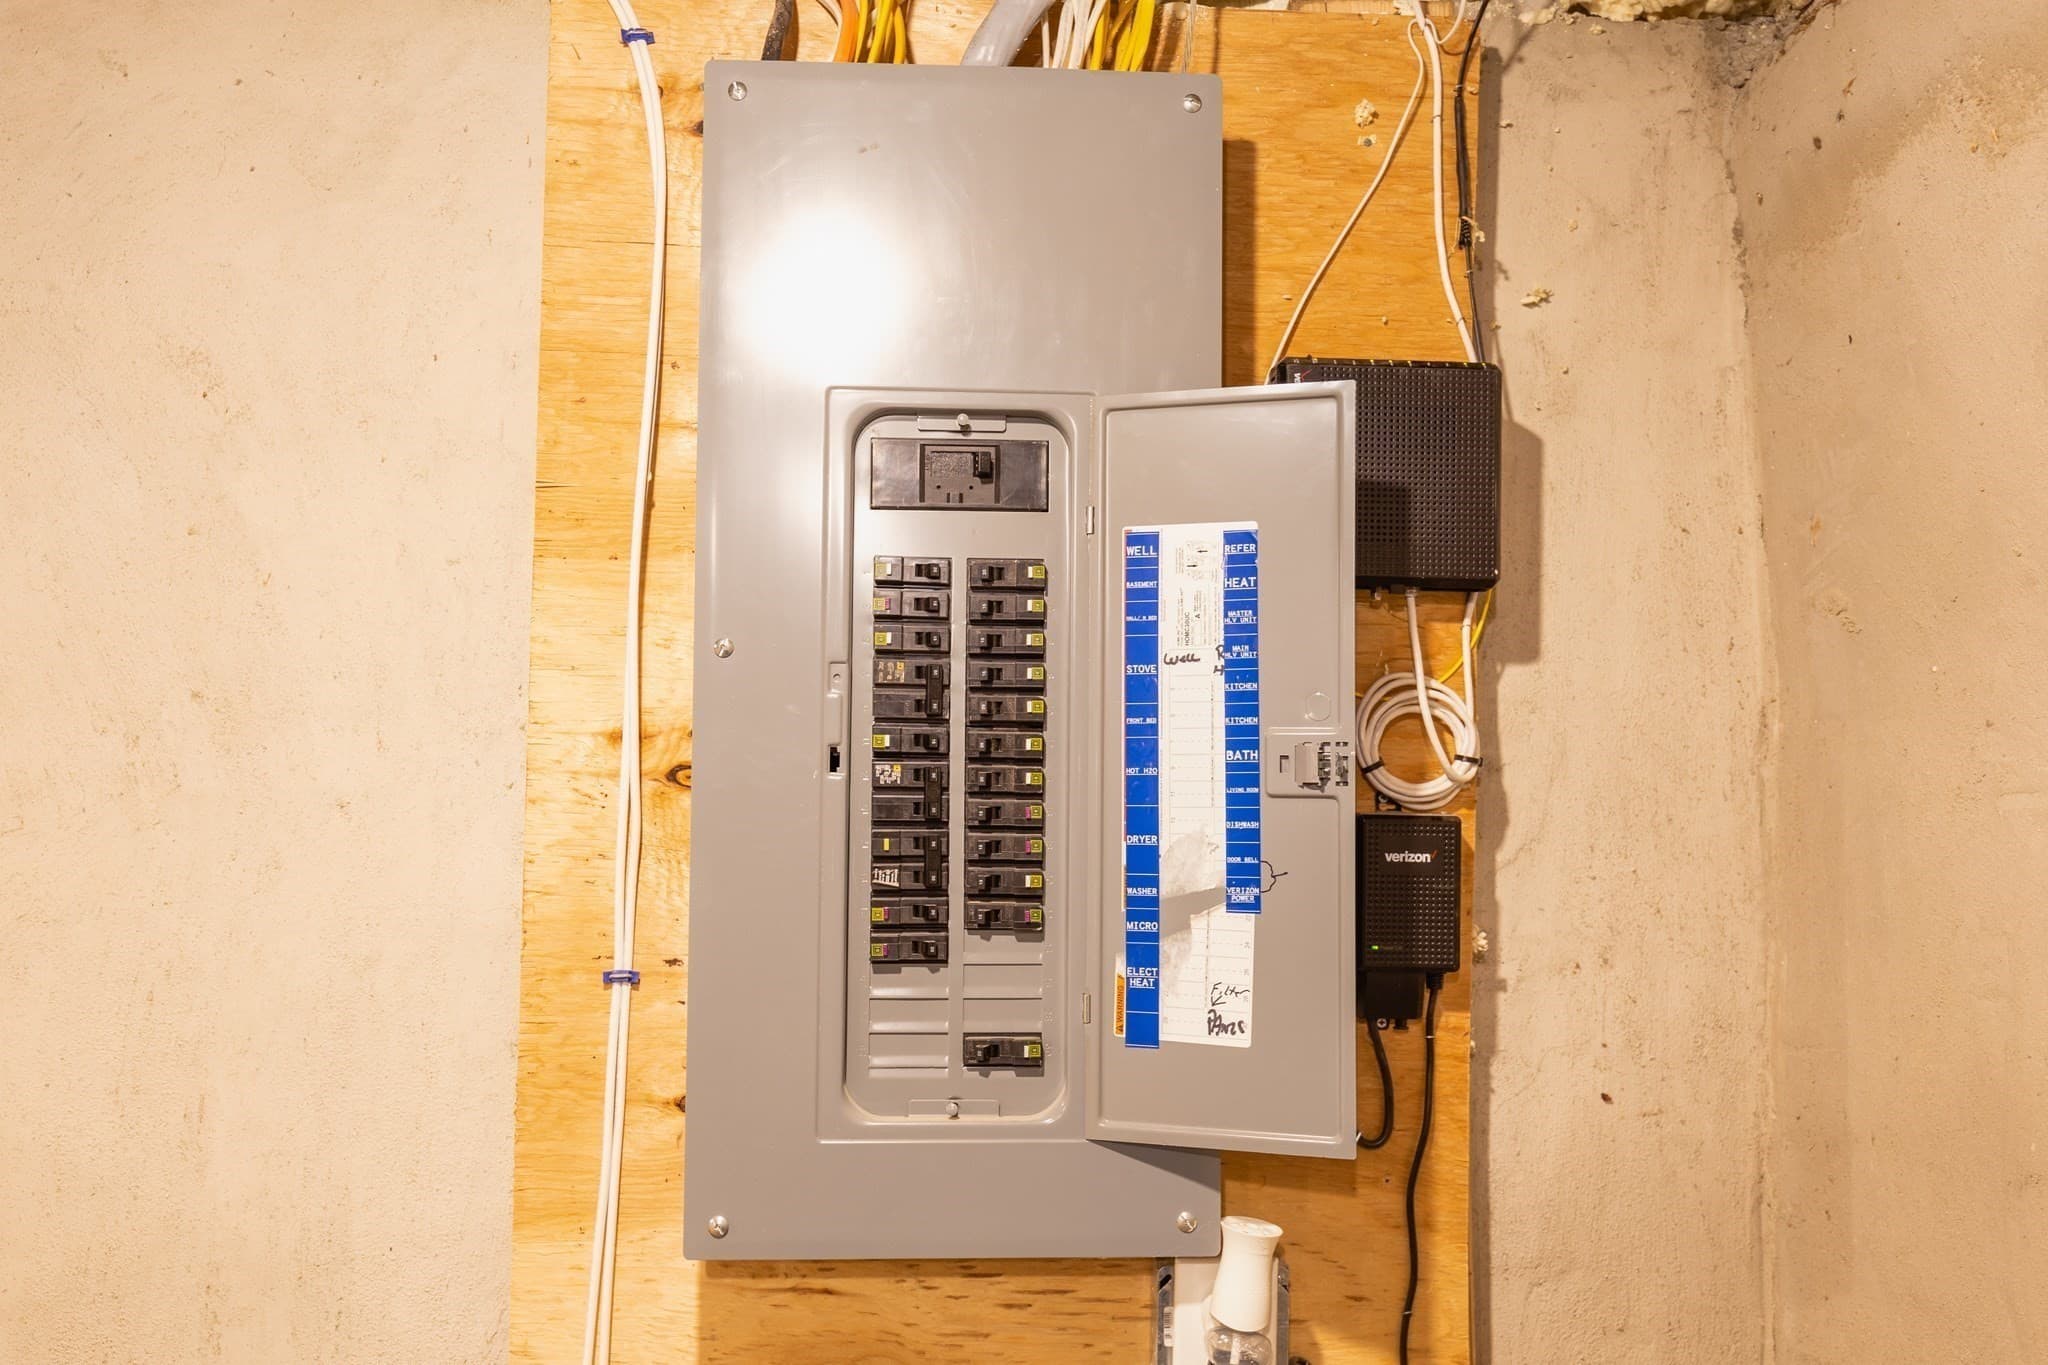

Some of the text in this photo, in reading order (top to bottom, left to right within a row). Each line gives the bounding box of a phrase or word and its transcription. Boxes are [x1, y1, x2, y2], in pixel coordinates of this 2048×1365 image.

[1126, 546, 1157, 556] WELL
[1224, 544, 1256, 553] REFER
[1224, 577, 1257, 588] HEAT
[1163, 653, 1200, 665] Well
[1126, 664, 1157, 673] STOVE
[1226, 750, 1258, 760] BATH
[1226, 821, 1259, 829] DISHWASH
[1126, 835, 1158, 844] DRYER
[1384, 851, 1432, 863] verizon
[1126, 887, 1157, 895] WASHER
[1126, 922, 1158, 930] MICRO
[1127, 967, 1158, 976] ELECT
[1130, 978, 1155, 987] HEAT
